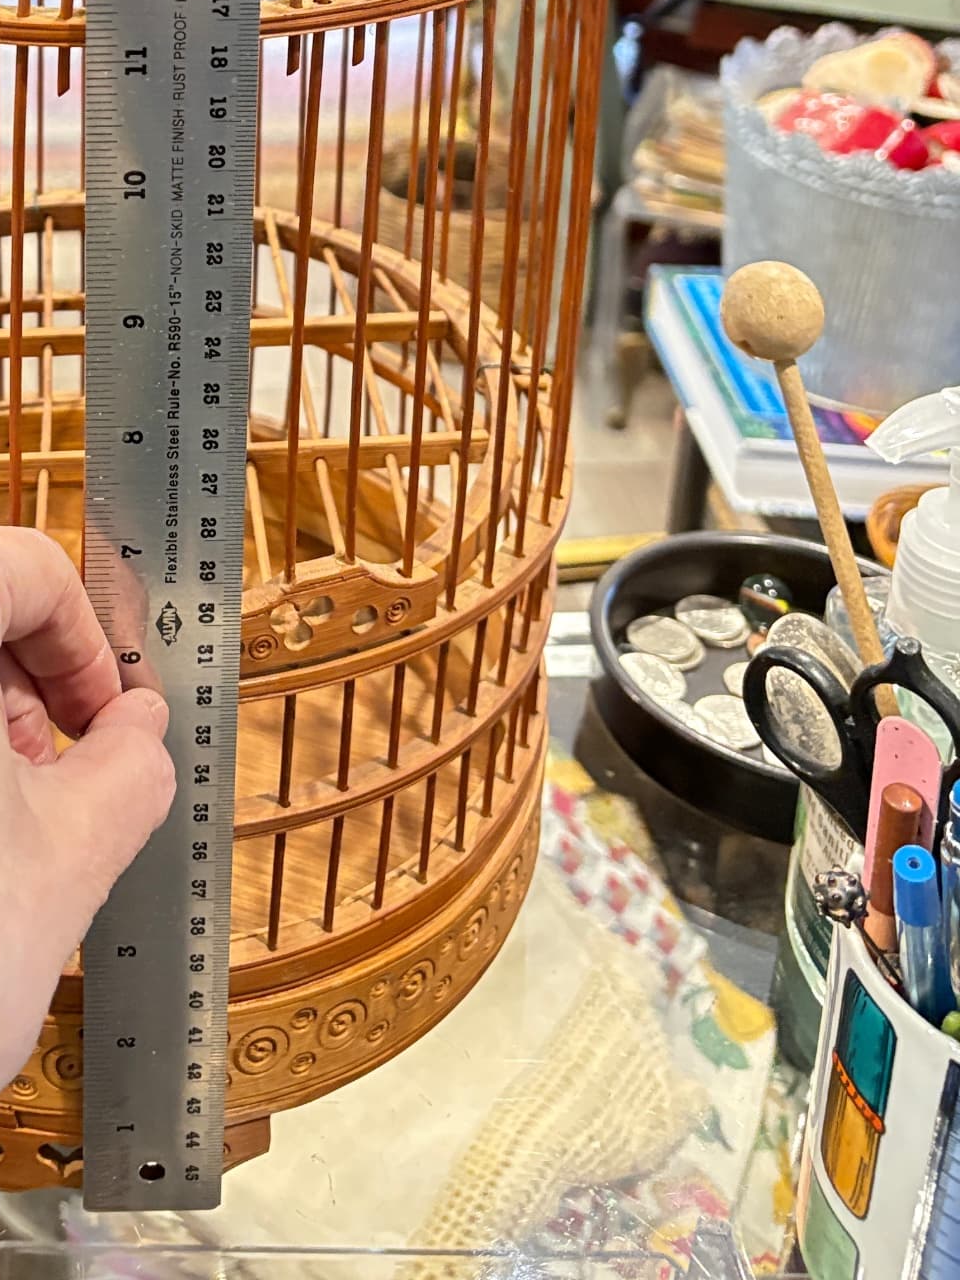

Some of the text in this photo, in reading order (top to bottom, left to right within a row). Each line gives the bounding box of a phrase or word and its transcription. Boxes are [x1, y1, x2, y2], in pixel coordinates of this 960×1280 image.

[174, 11, 187, 59] PROOF
[124, 46, 148, 76] 11
[210, 46, 228, 69] 18
[172, 61, 186, 102] RUST
[209, 96, 227, 119] 19
[171, 108, 185, 154] FINISH
[208, 145, 226, 169] 20
[123, 170, 146, 200] 10
[170, 158, 185, 201] MATTE
[207, 194, 225, 217] 21
[206, 242, 224, 266] 22
[205, 290, 223, 313] 23
[122, 314, 145, 329] 9
[204, 337, 221, 360] 24
[203, 383, 220, 405] 25
[123, 430, 144, 445] 8
[166, 424, 180, 460] Steel
[202, 428, 219, 451] 26
[201, 473, 218, 495] 27
[165, 465, 179, 527] Stainless
[200, 517, 217, 539] 28
[121, 545, 143, 559] 7
[165, 531, 177, 584] Flexible
[199, 560, 216, 582] 29
[160, 606, 177, 642] ALVIN
[198, 603, 215, 624] 30
[119, 651, 141, 665] 6
[197, 644, 214, 665] 31
[196, 685, 213, 706] 32
[195, 725, 211, 745] 33
[194, 764, 210, 784] 34
[193, 803, 209, 823] 35
[192, 841, 208, 861] 36
[191, 879, 207, 898] 37
[190, 917, 206, 936] 38
[117, 945, 137, 957] 3
[189, 954, 205, 972] 39
[188, 990, 204, 1009] 40
[116, 1037, 136, 1048] 2
[187, 1026, 203, 1044] 41
[187, 1062, 202, 1080] 42
[186, 1097, 201, 1115] 43
[116, 1124, 134, 1132] 1
[185, 1131, 200, 1149] 44
[184, 1165, 199, 1181] 45
